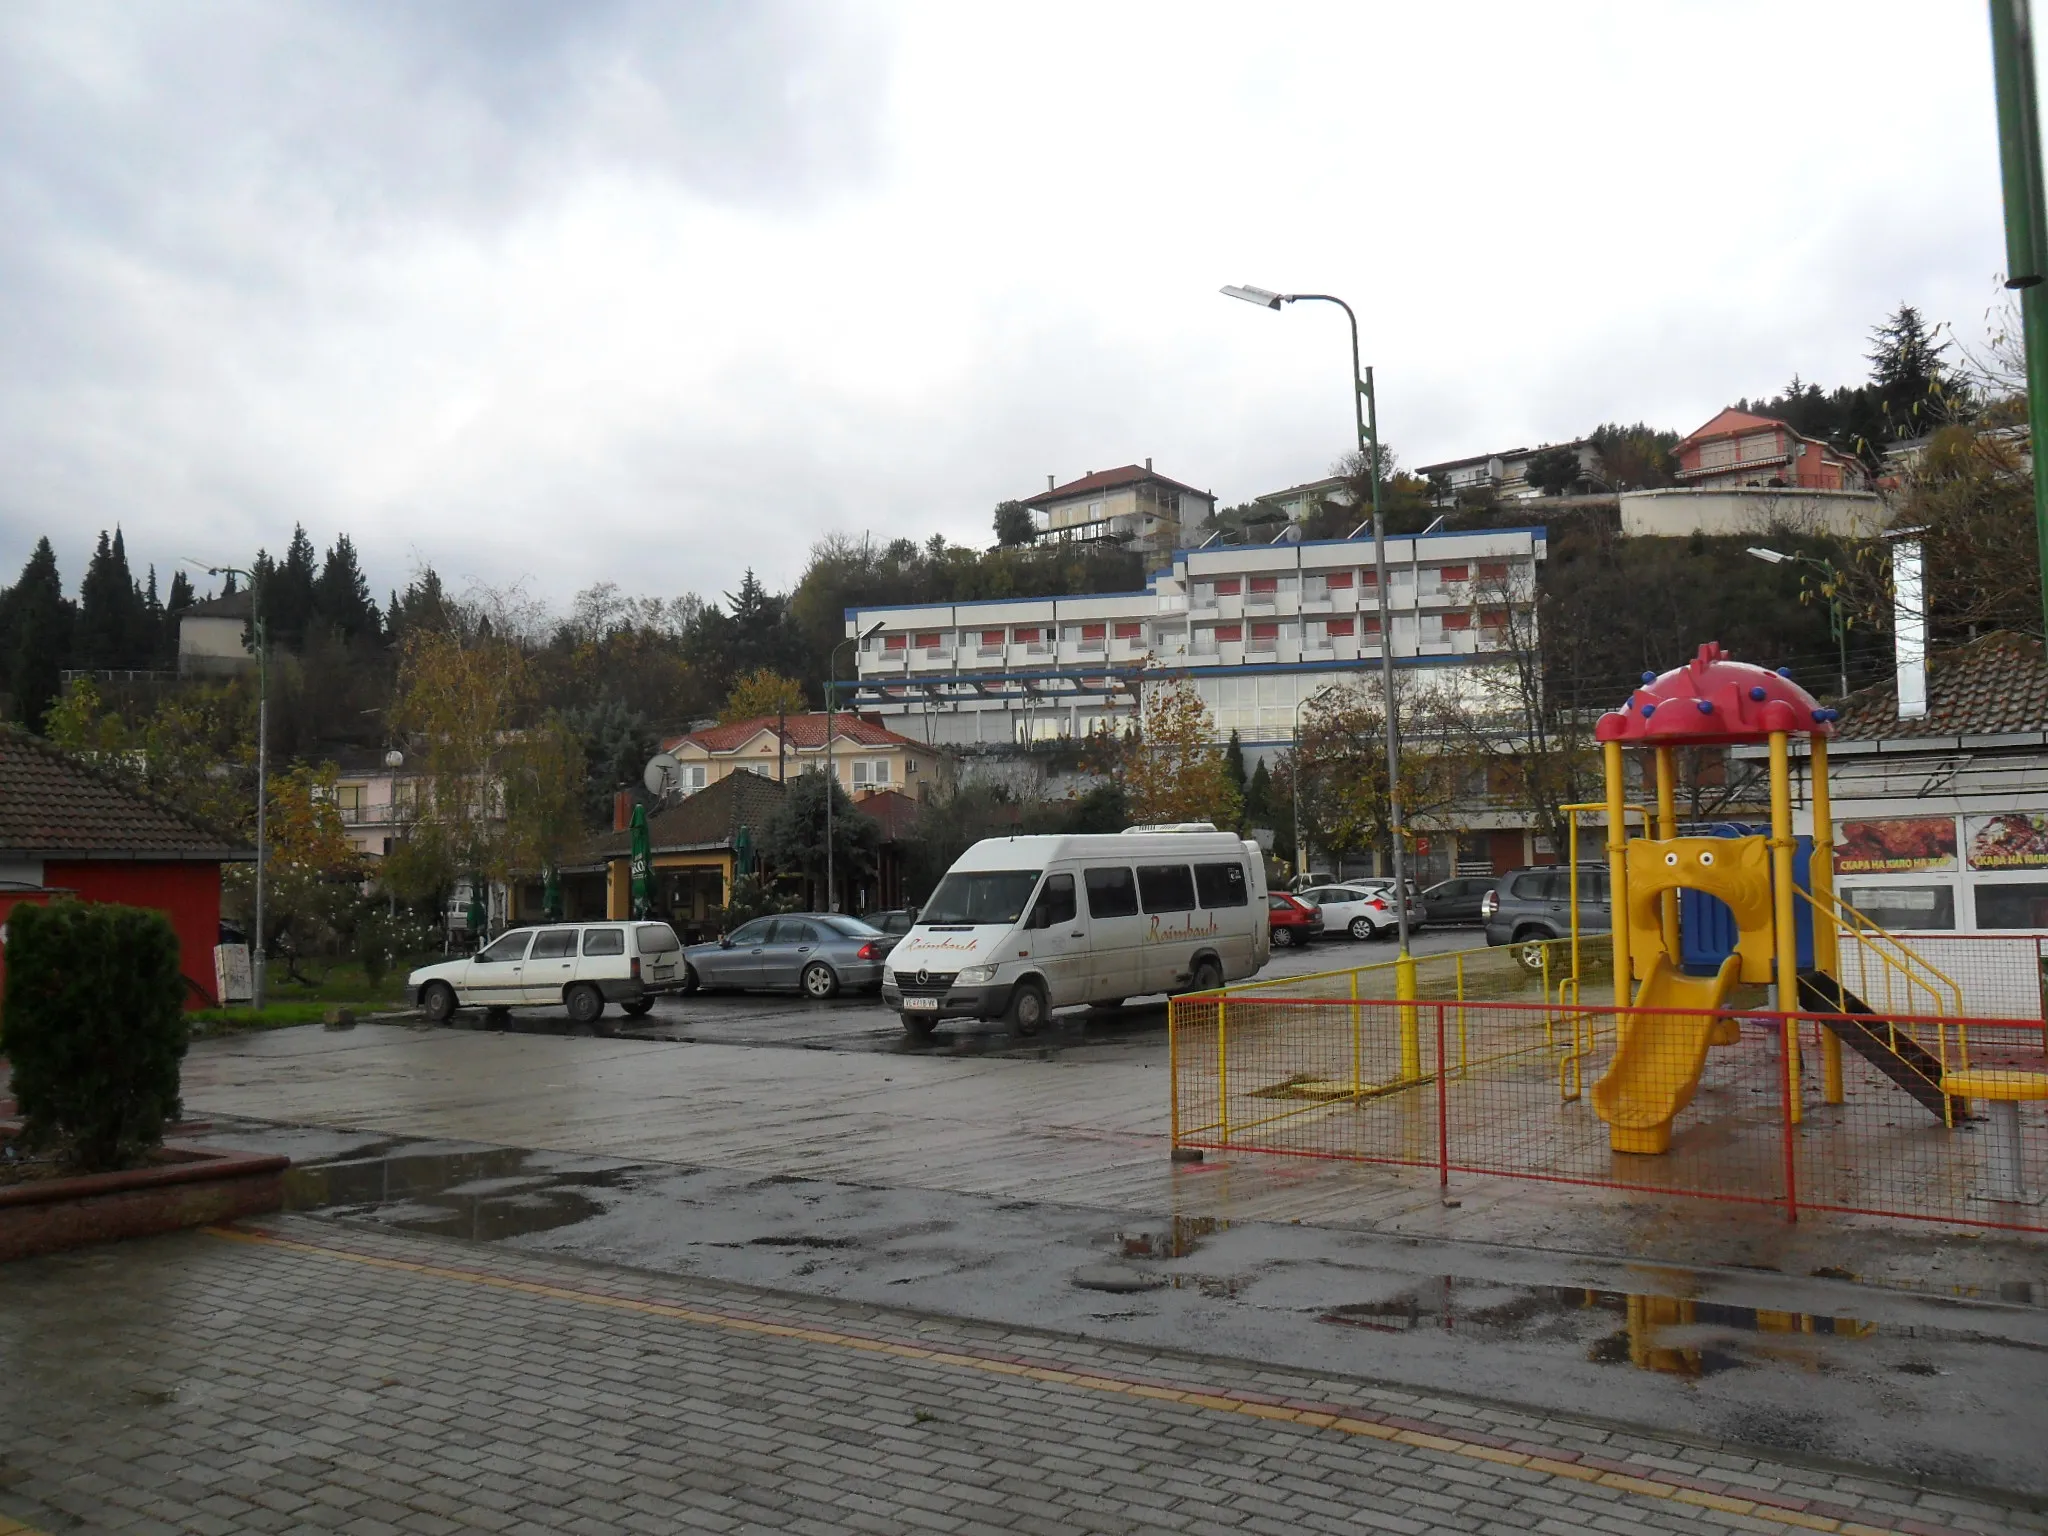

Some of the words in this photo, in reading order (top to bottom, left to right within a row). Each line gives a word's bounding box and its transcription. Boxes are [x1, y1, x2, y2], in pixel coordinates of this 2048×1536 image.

[1840, 859, 1870, 870] СКАРА
[1871, 859, 1885, 869] НА
[2008, 854, 2022, 865] НА
